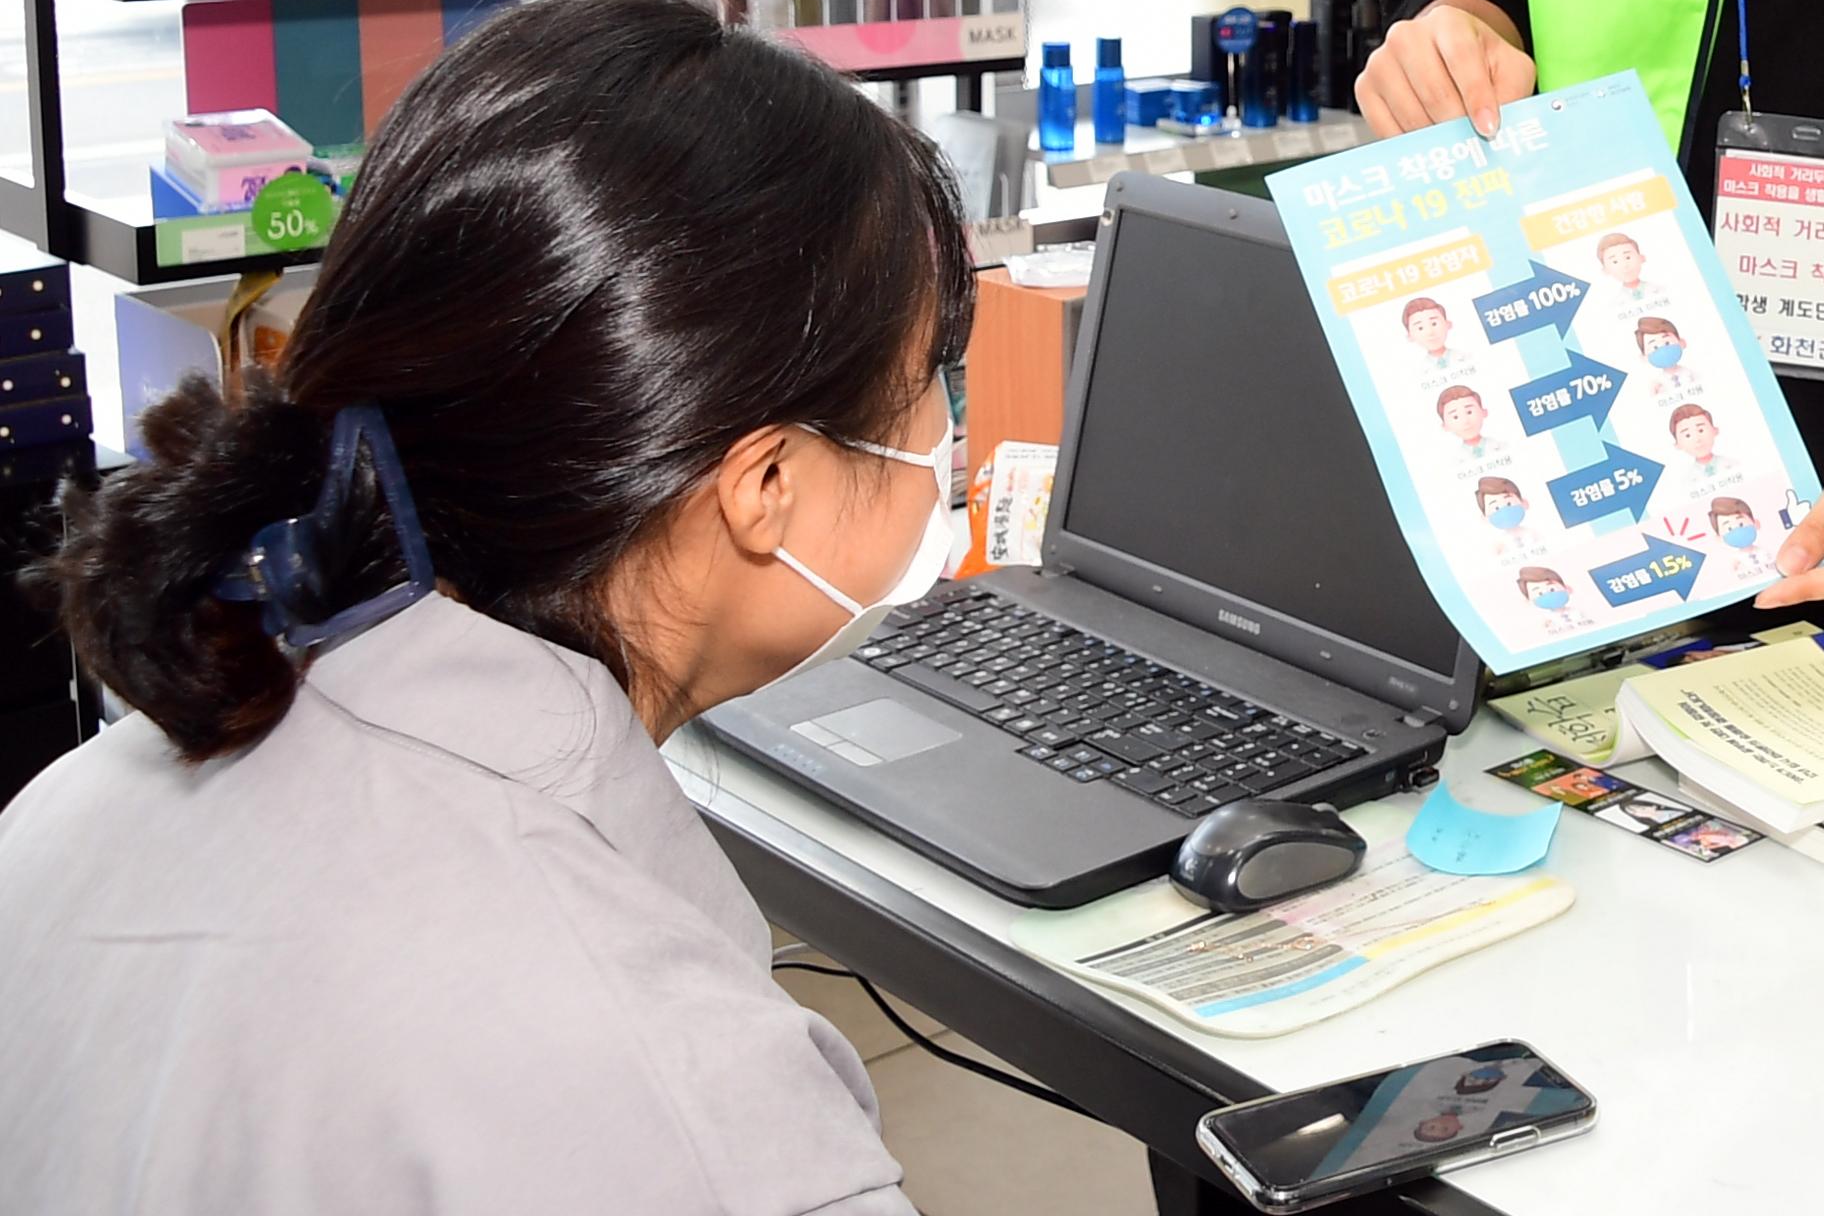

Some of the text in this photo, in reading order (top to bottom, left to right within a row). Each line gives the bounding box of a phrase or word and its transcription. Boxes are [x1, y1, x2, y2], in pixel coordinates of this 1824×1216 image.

[968, 27, 1017, 44] MASK
[1303, 163, 1397, 212] 마스크
[1399, 135, 1489, 186] 착용에
[1723, 179, 1760, 196] 마스크
[1764, 183, 1800, 201] 착용을
[1749, 162, 1785, 179] 사회적
[266, 209, 320, 240] 50%
[1319, 167, 1515, 251] 코로나 19 전파
[1551, 190, 1646, 235] 건강한 사람
[1720, 211, 1781, 237] 사회적
[1337, 245, 1481, 306] 코로나 19 감염자
[1739, 254, 1799, 281] 마스크
[1483, 282, 1581, 328] 감염률 100%
[1526, 373, 1613, 417] 감염률 70%
[1569, 468, 1644, 508] 감염률 5%
[1606, 554, 1693, 594] 감염률 1.5%
[1217, 608, 1261, 635] SAMSUNG
